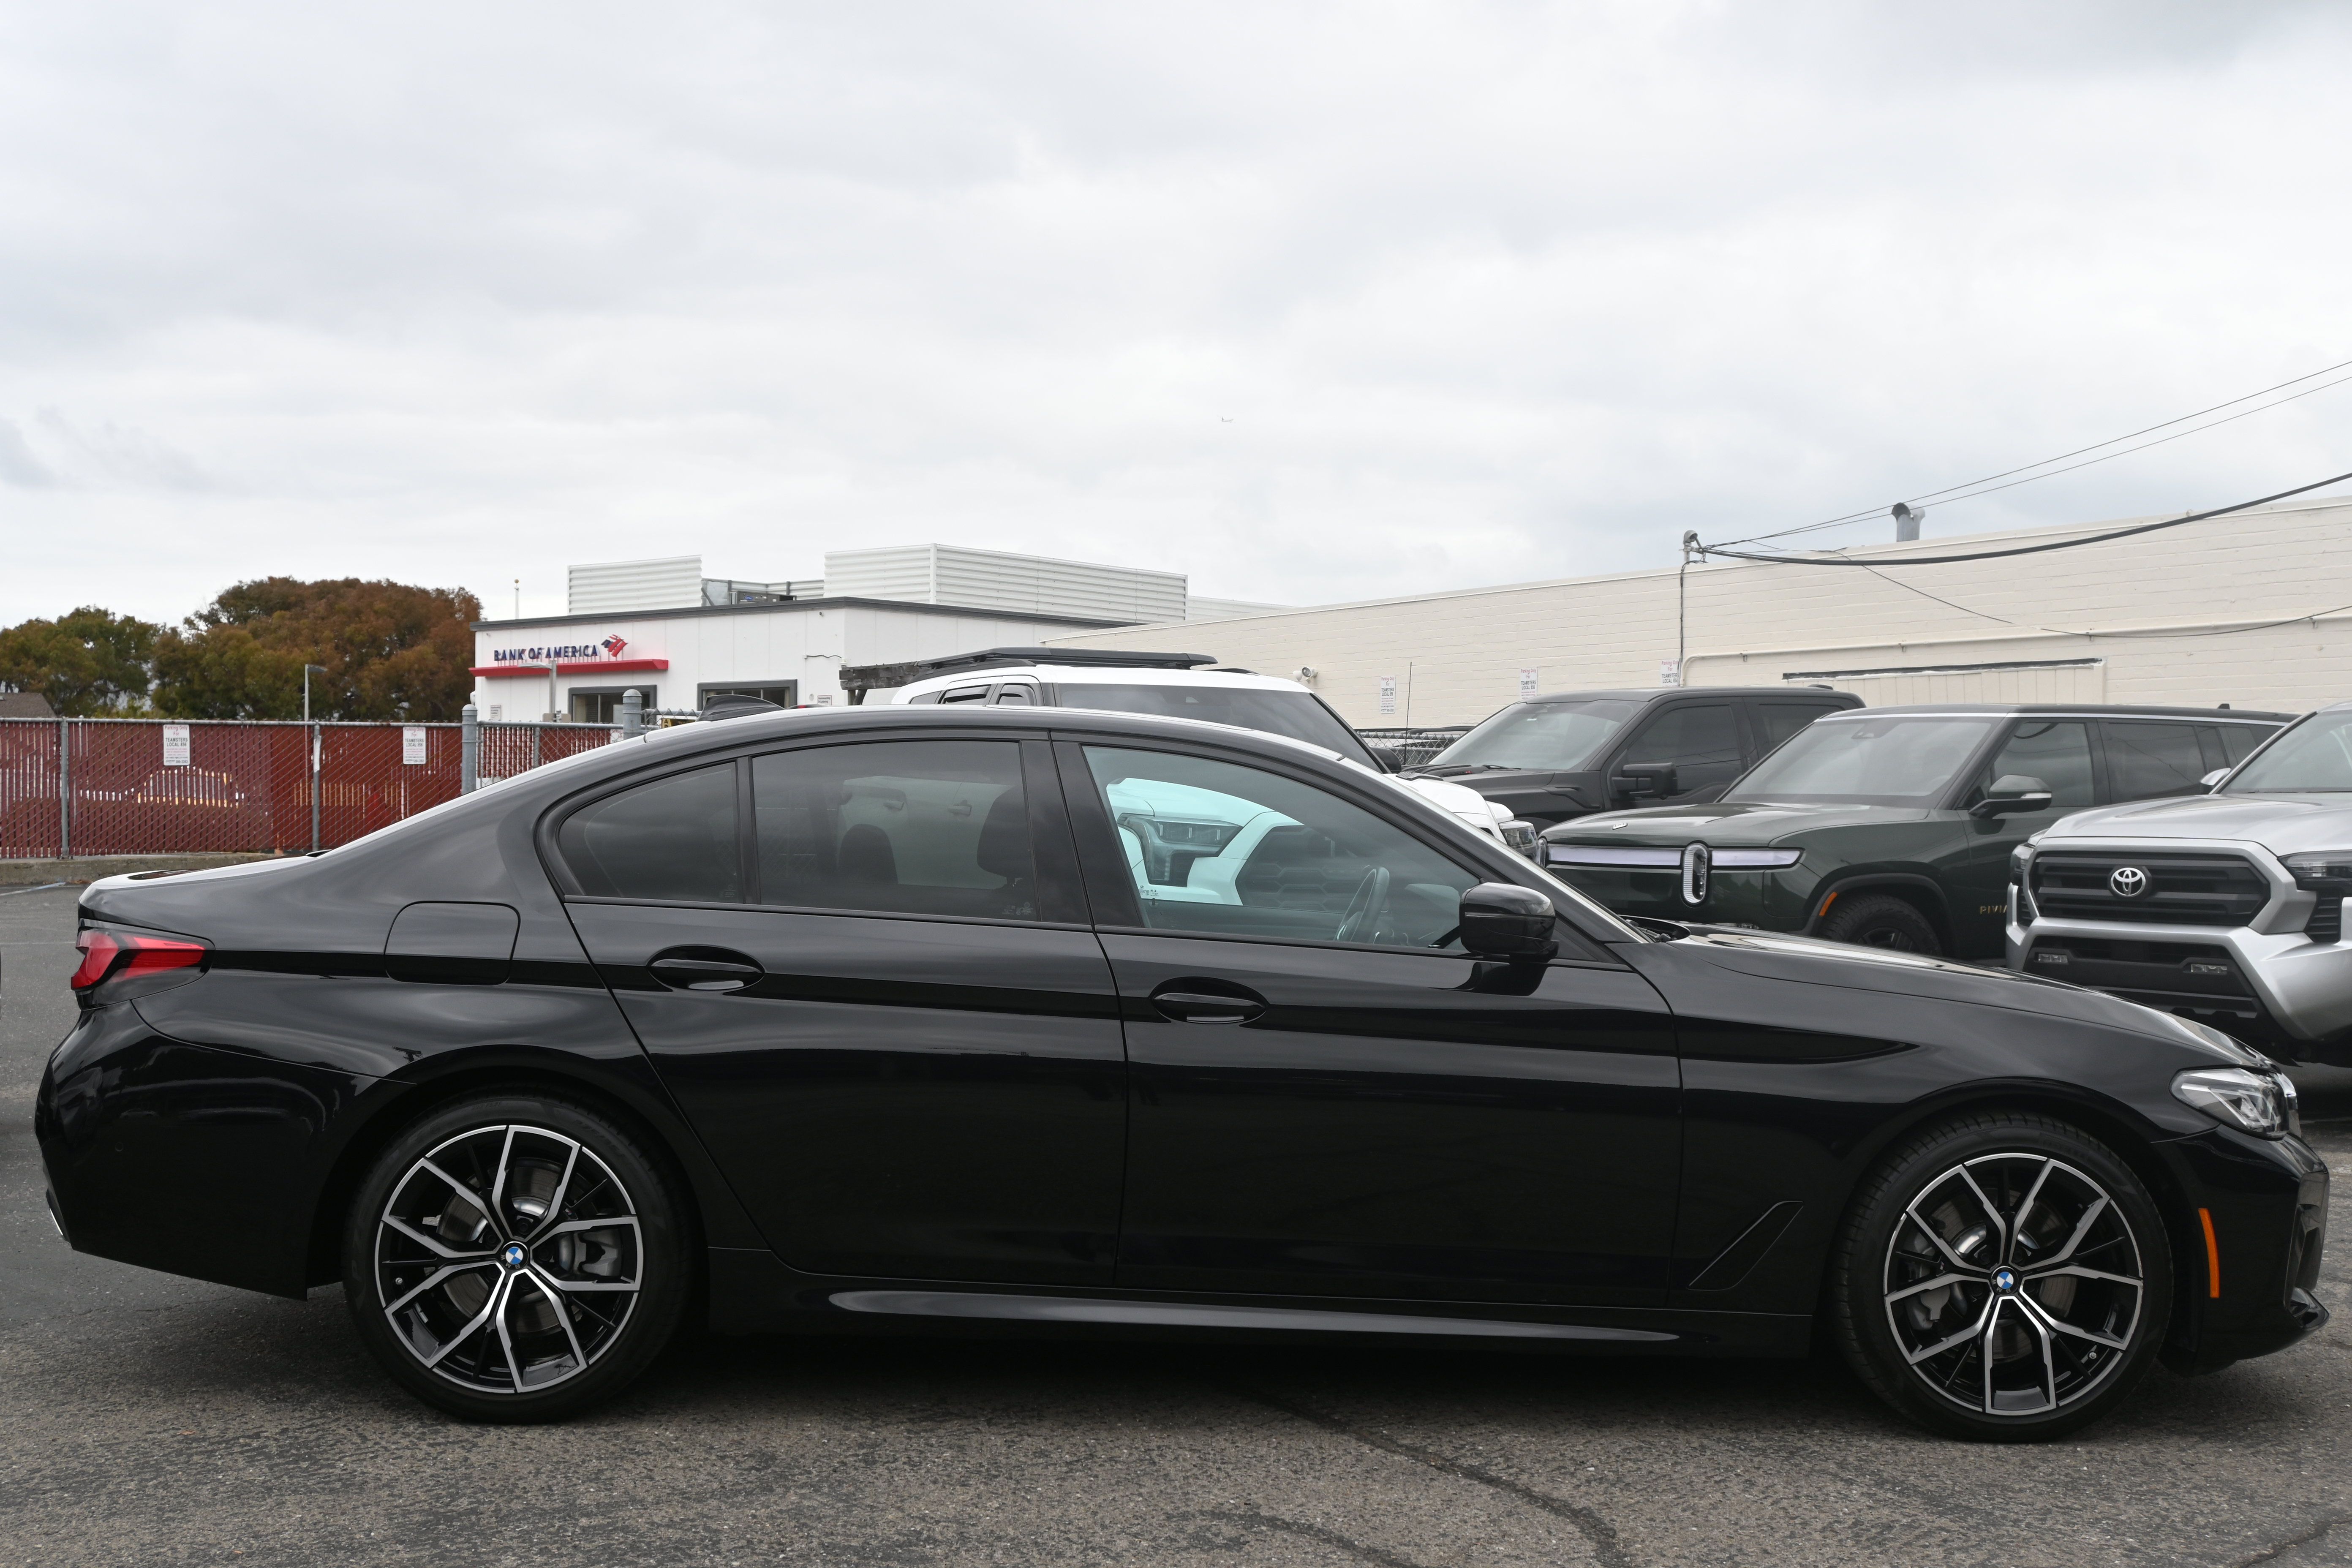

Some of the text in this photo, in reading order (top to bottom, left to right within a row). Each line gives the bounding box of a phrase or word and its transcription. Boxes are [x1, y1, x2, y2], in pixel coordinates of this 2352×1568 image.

[494, 645, 599, 661] BANK OF AMERICA
